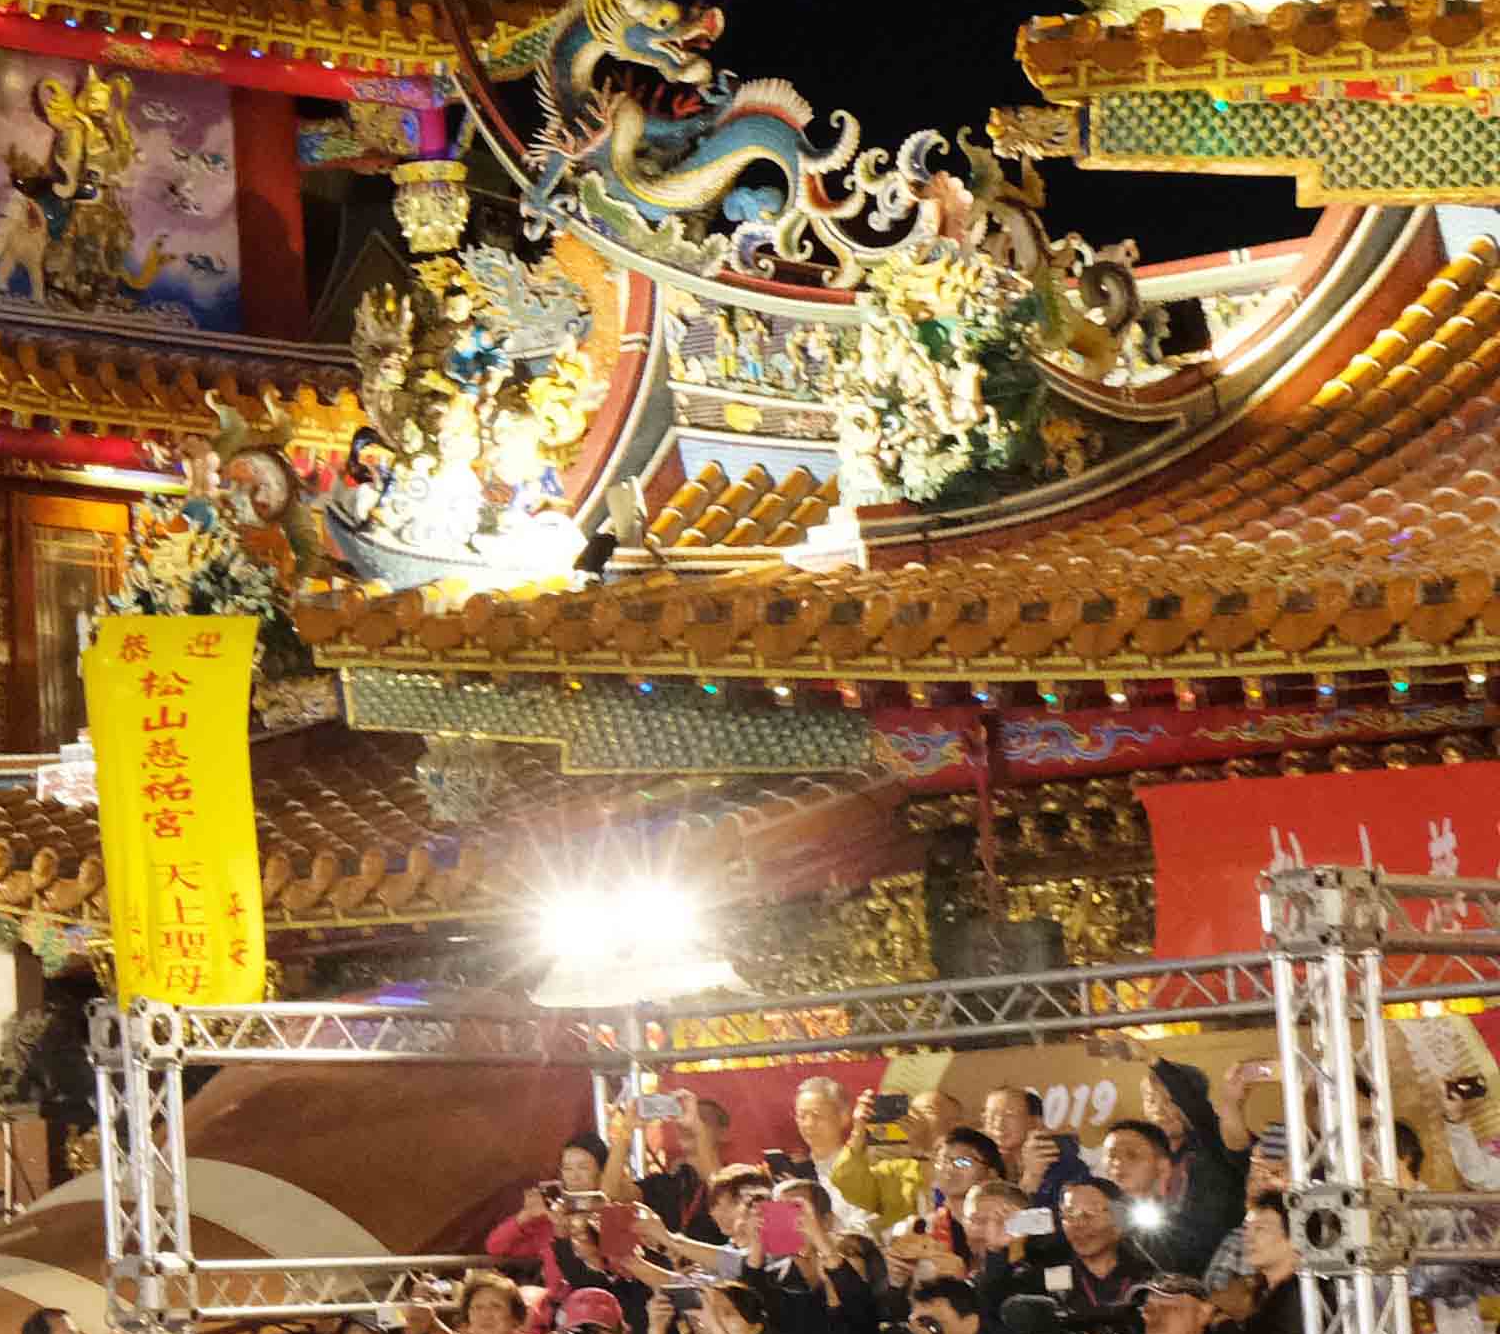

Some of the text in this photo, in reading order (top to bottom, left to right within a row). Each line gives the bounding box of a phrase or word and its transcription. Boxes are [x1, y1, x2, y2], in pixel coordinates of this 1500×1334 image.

[139, 670, 195, 840] 松山慈祐宮
